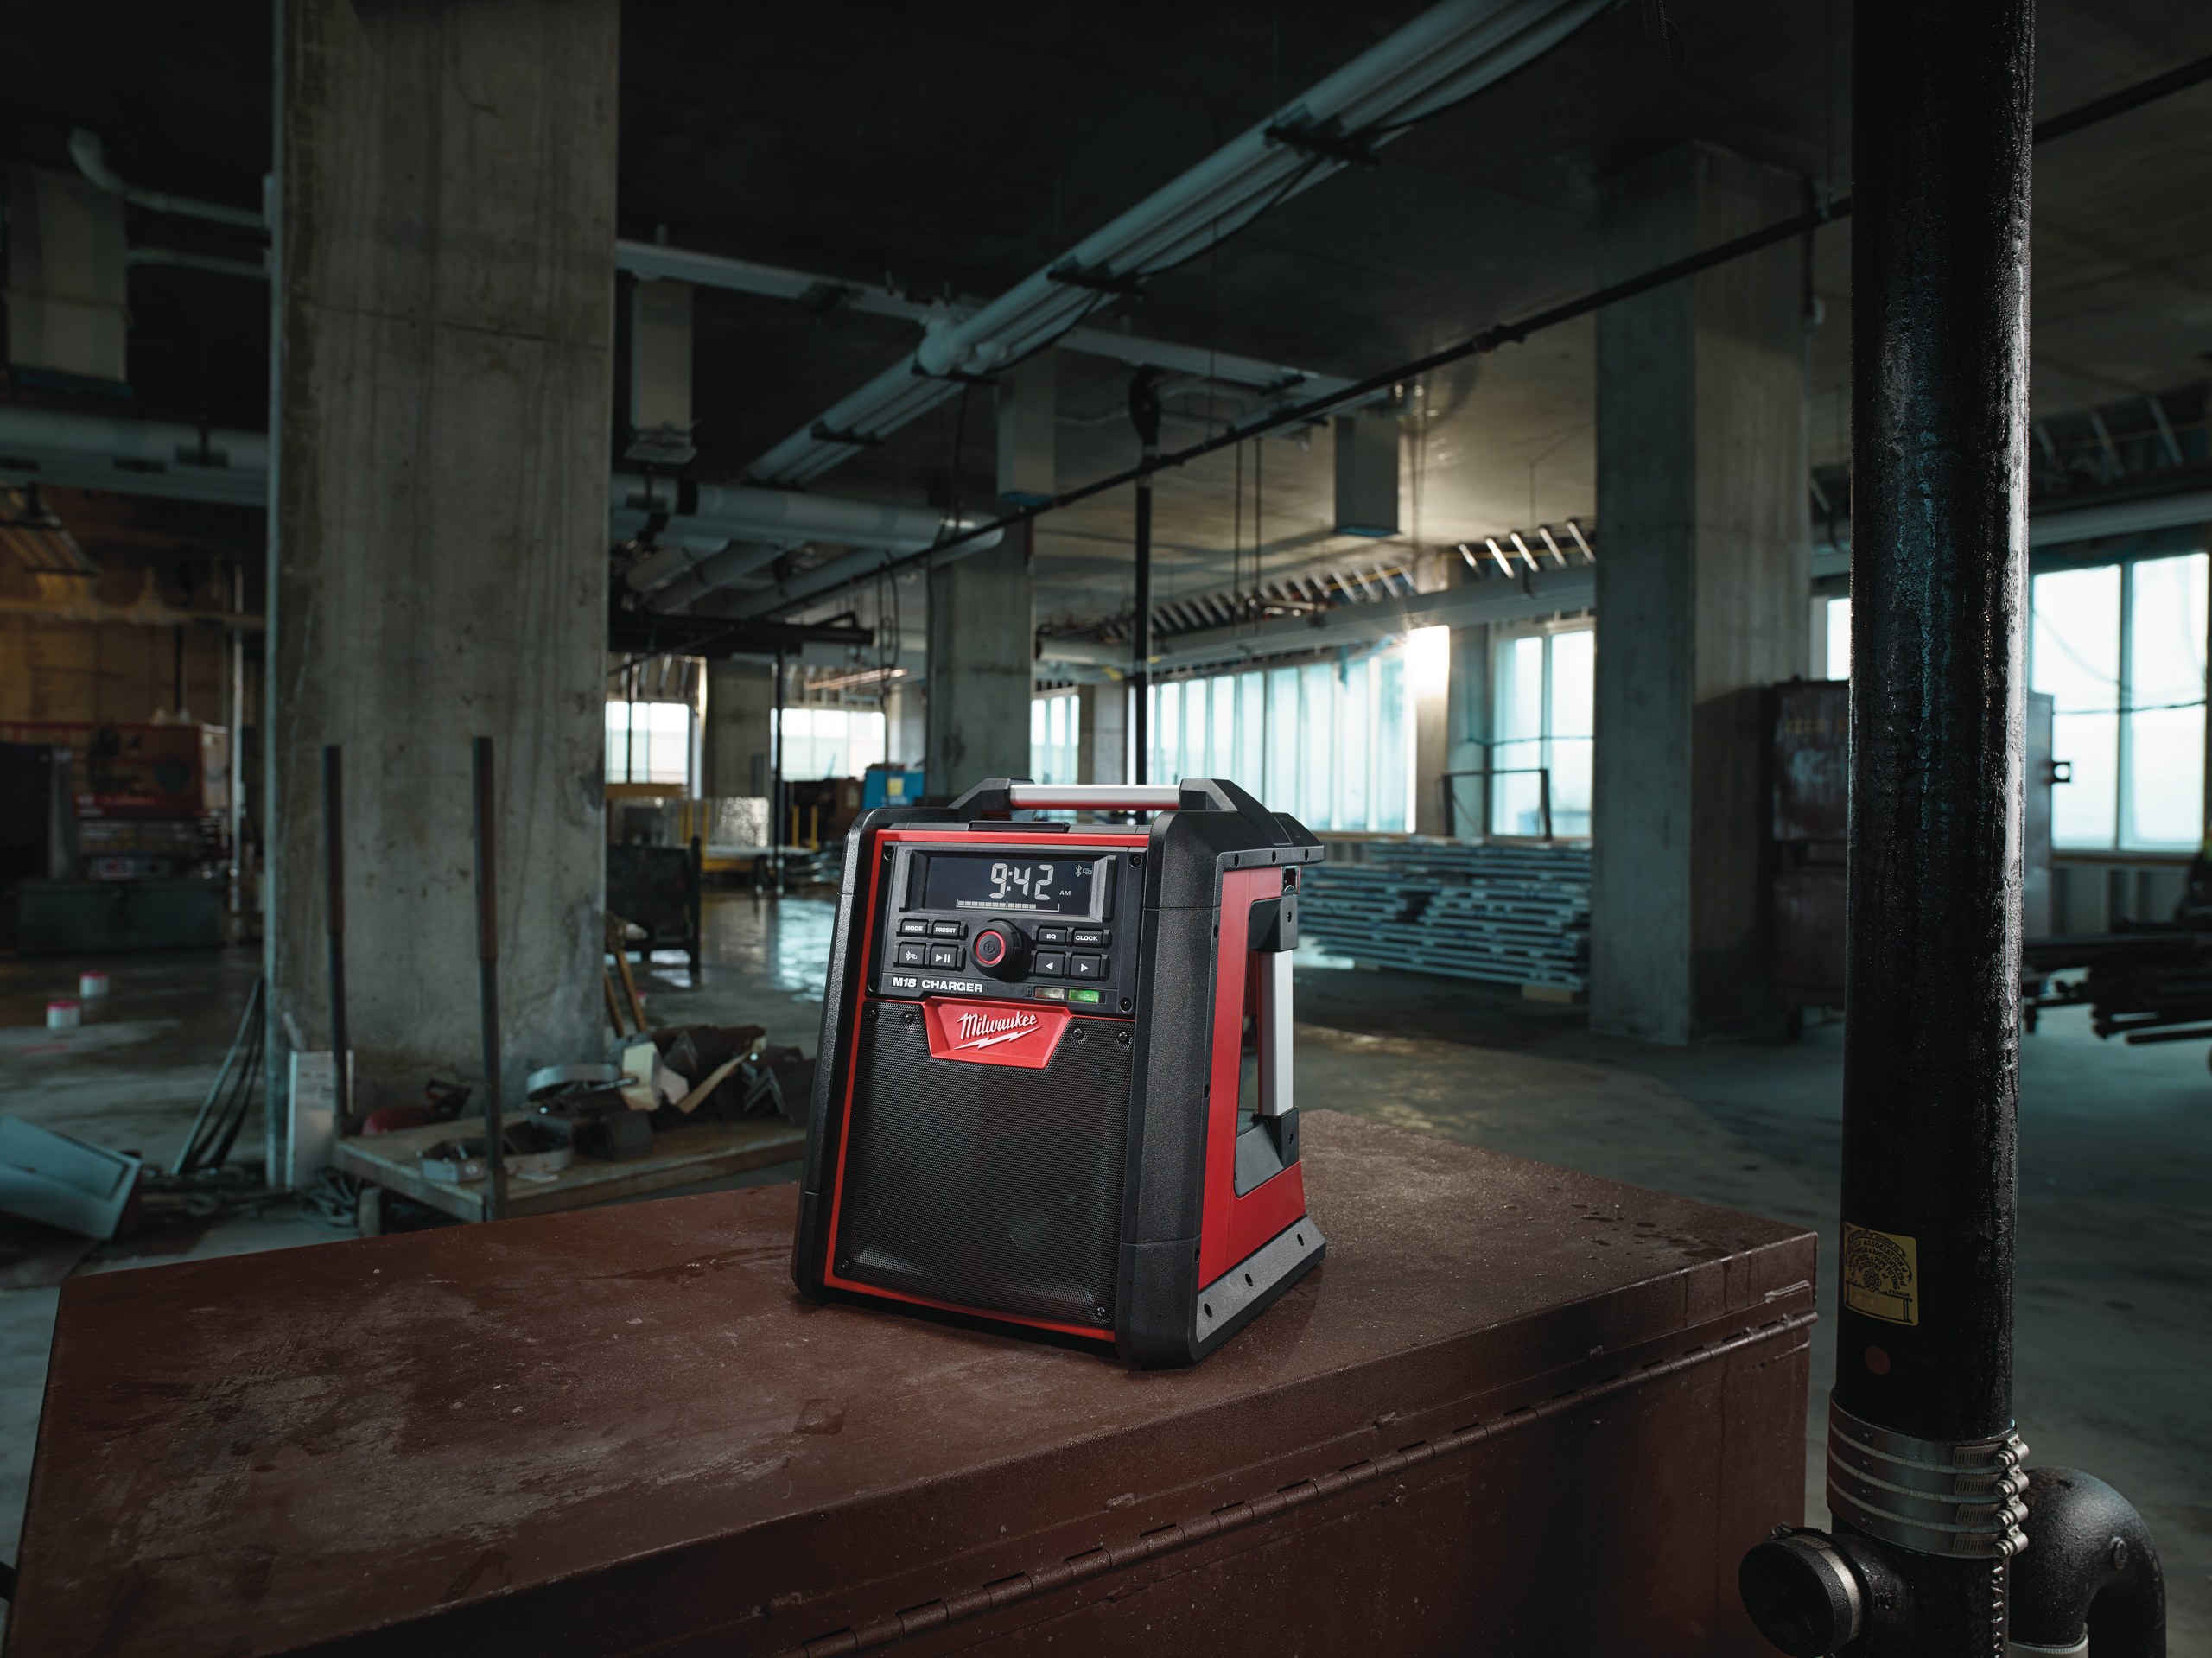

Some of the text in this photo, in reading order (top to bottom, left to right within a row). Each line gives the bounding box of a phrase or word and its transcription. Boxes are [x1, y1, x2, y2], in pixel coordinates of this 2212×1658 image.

[988, 862, 1054, 901] 9:42
[893, 976, 983, 993] M18 CHARGER
[956, 1011, 1038, 1040] Milwaukee
[1864, 1239, 1904, 1267] ASSOCIATION
[1874, 1256, 1887, 1268] PIPE
[1885, 1267, 1901, 1290] FITTING
